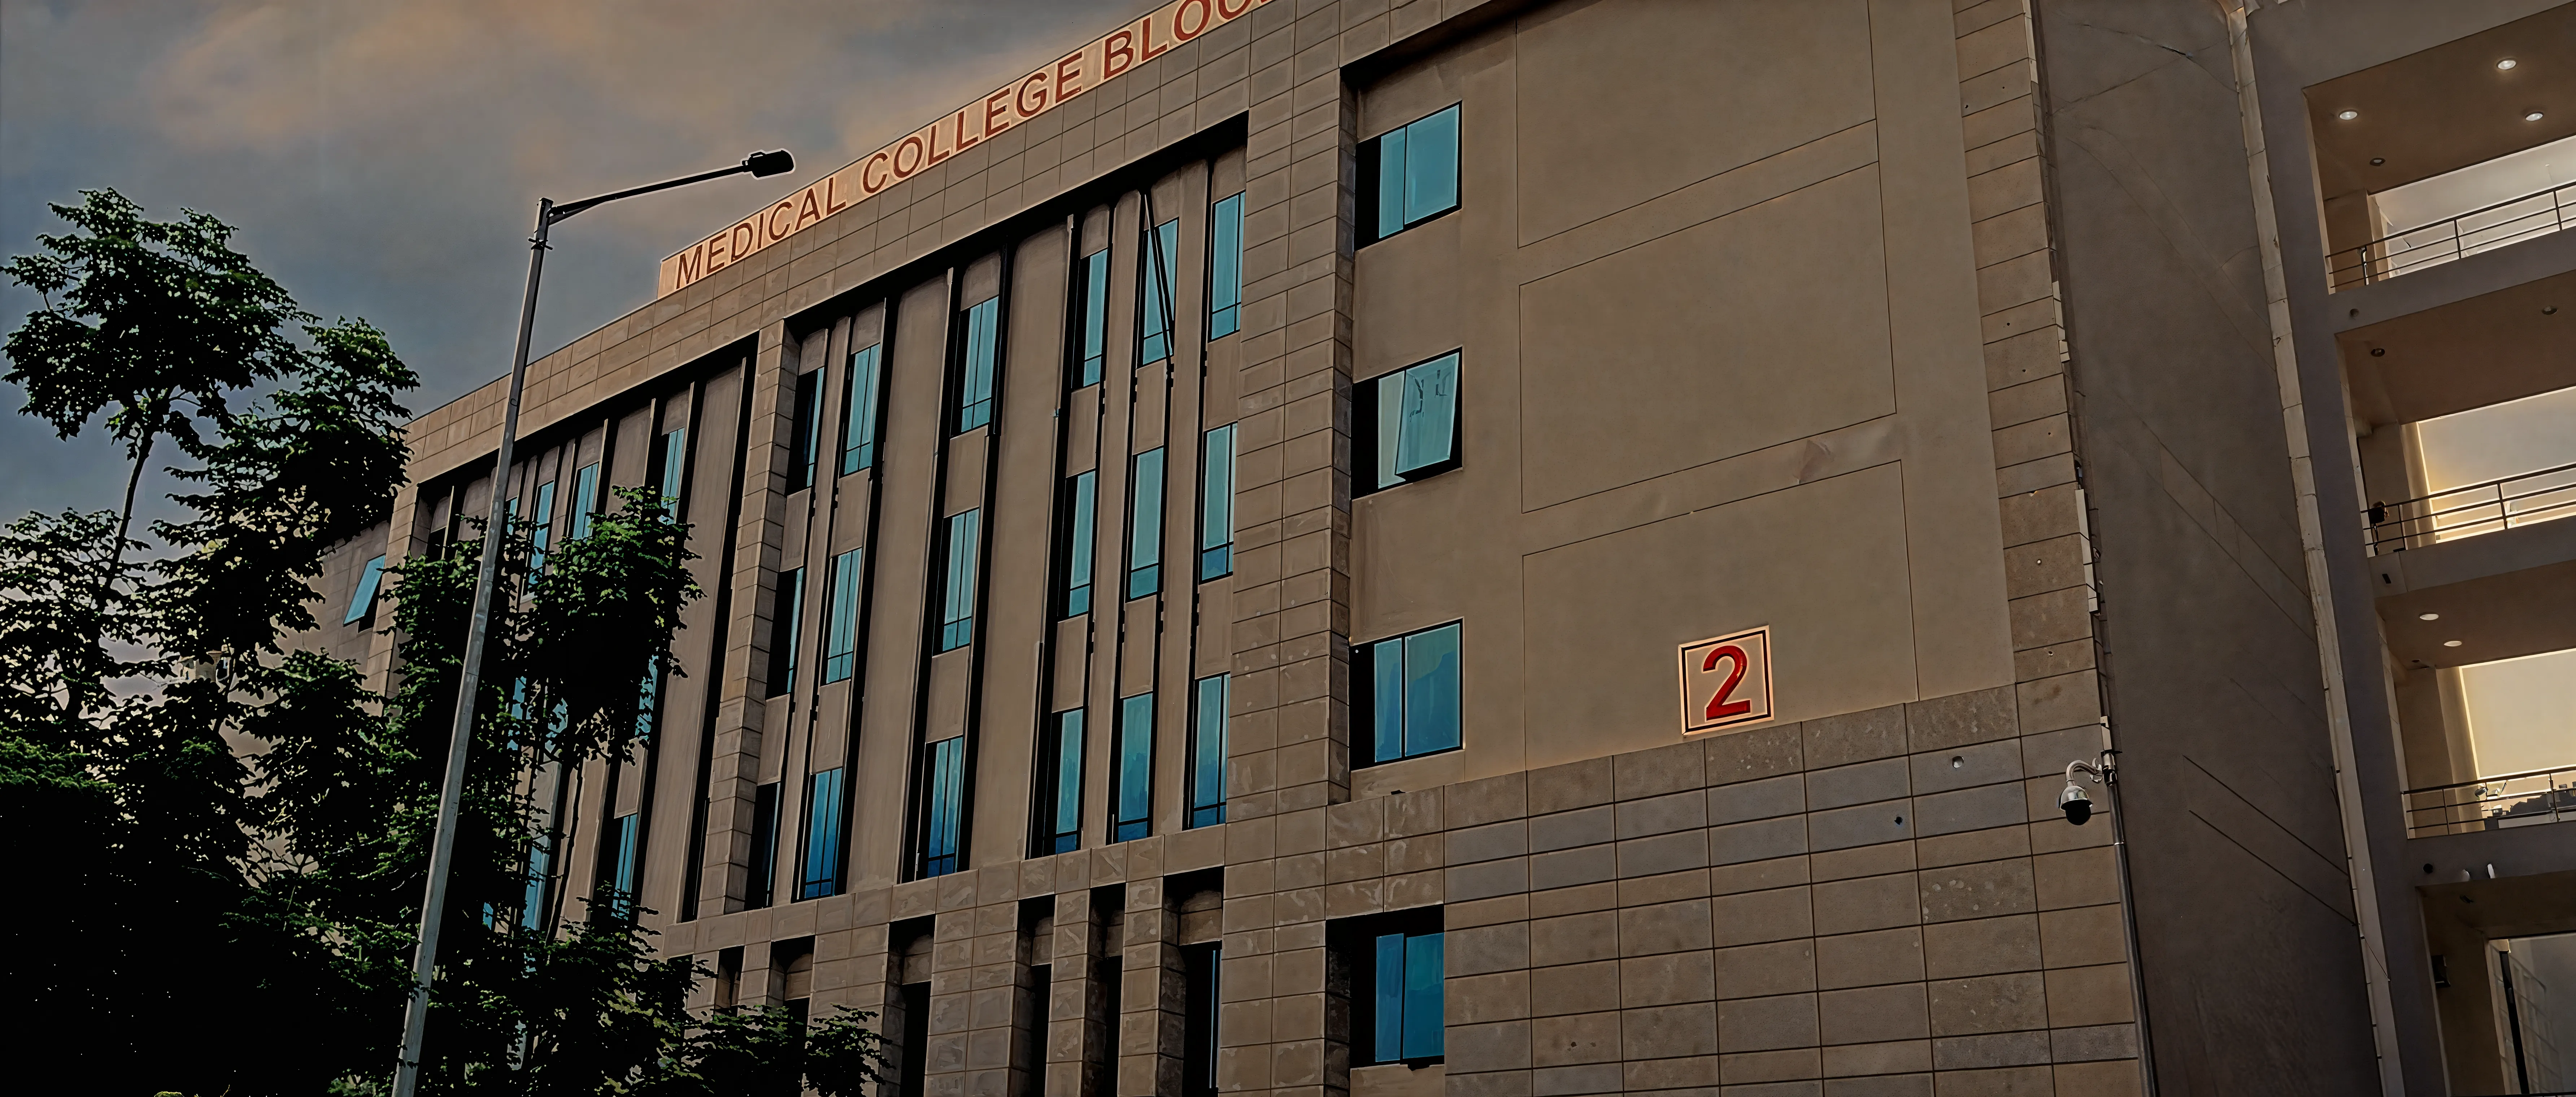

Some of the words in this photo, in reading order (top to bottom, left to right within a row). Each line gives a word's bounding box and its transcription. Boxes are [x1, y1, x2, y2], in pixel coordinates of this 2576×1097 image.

[676, 177, 847, 290] MEDICAL
[862, 51, 1083, 194] COLLEGE
[1104, 0, 1264, 80] BLO
[1702, 645, 1751, 721] 2
